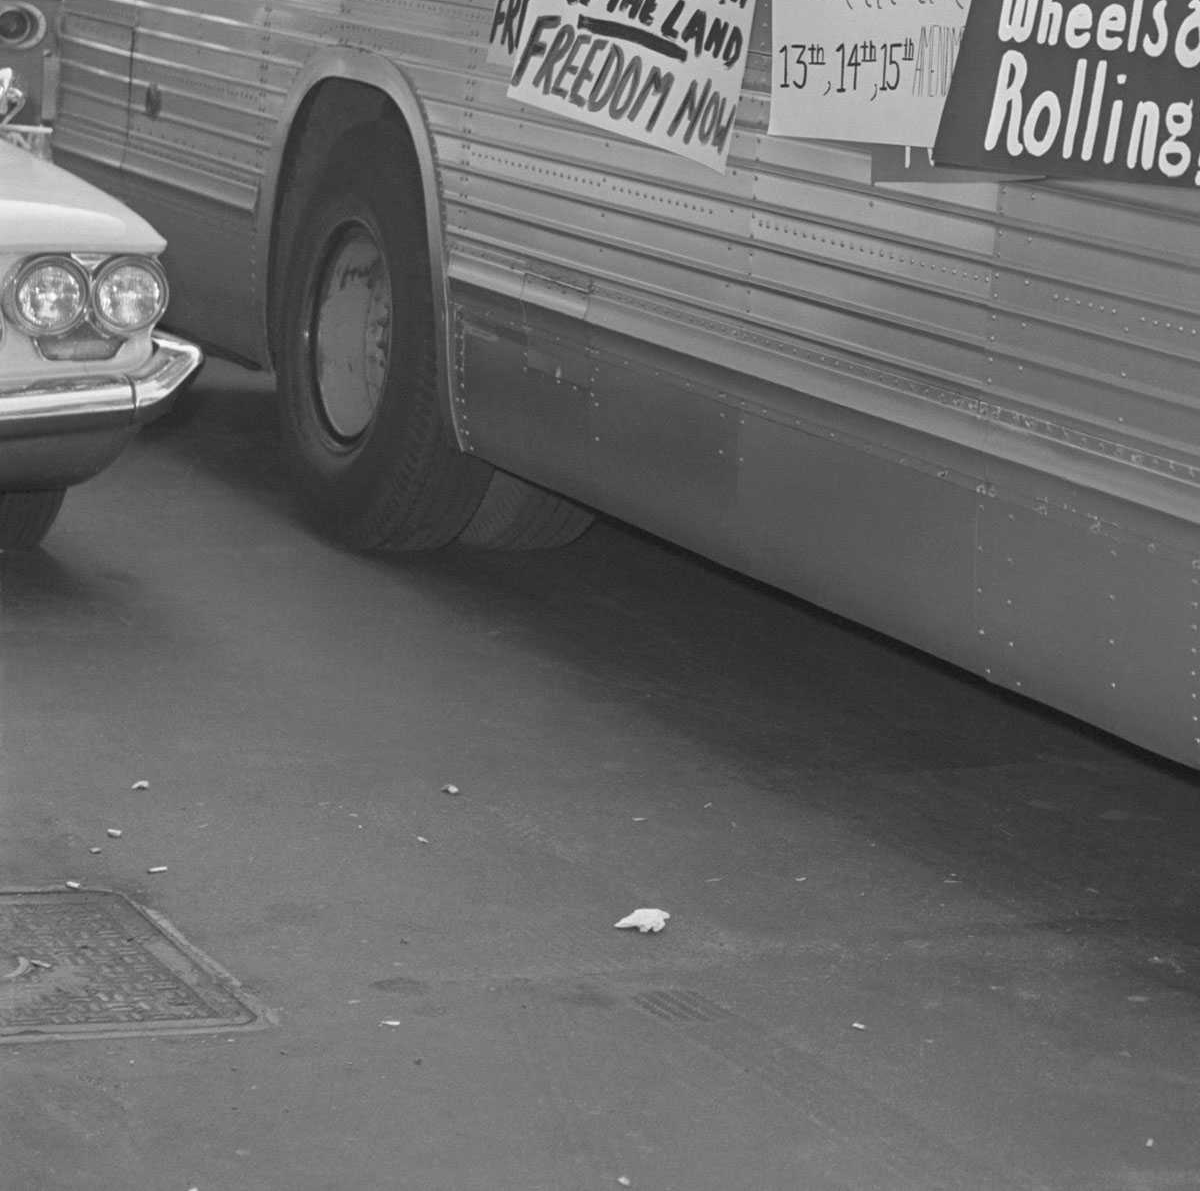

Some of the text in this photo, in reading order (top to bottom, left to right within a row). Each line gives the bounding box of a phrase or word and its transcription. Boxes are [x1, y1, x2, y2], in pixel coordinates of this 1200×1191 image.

[660, 0, 743, 70] LAND
[879, 37, 915, 92] 15th
[510, 14, 737, 155] FREEDOM NOW
